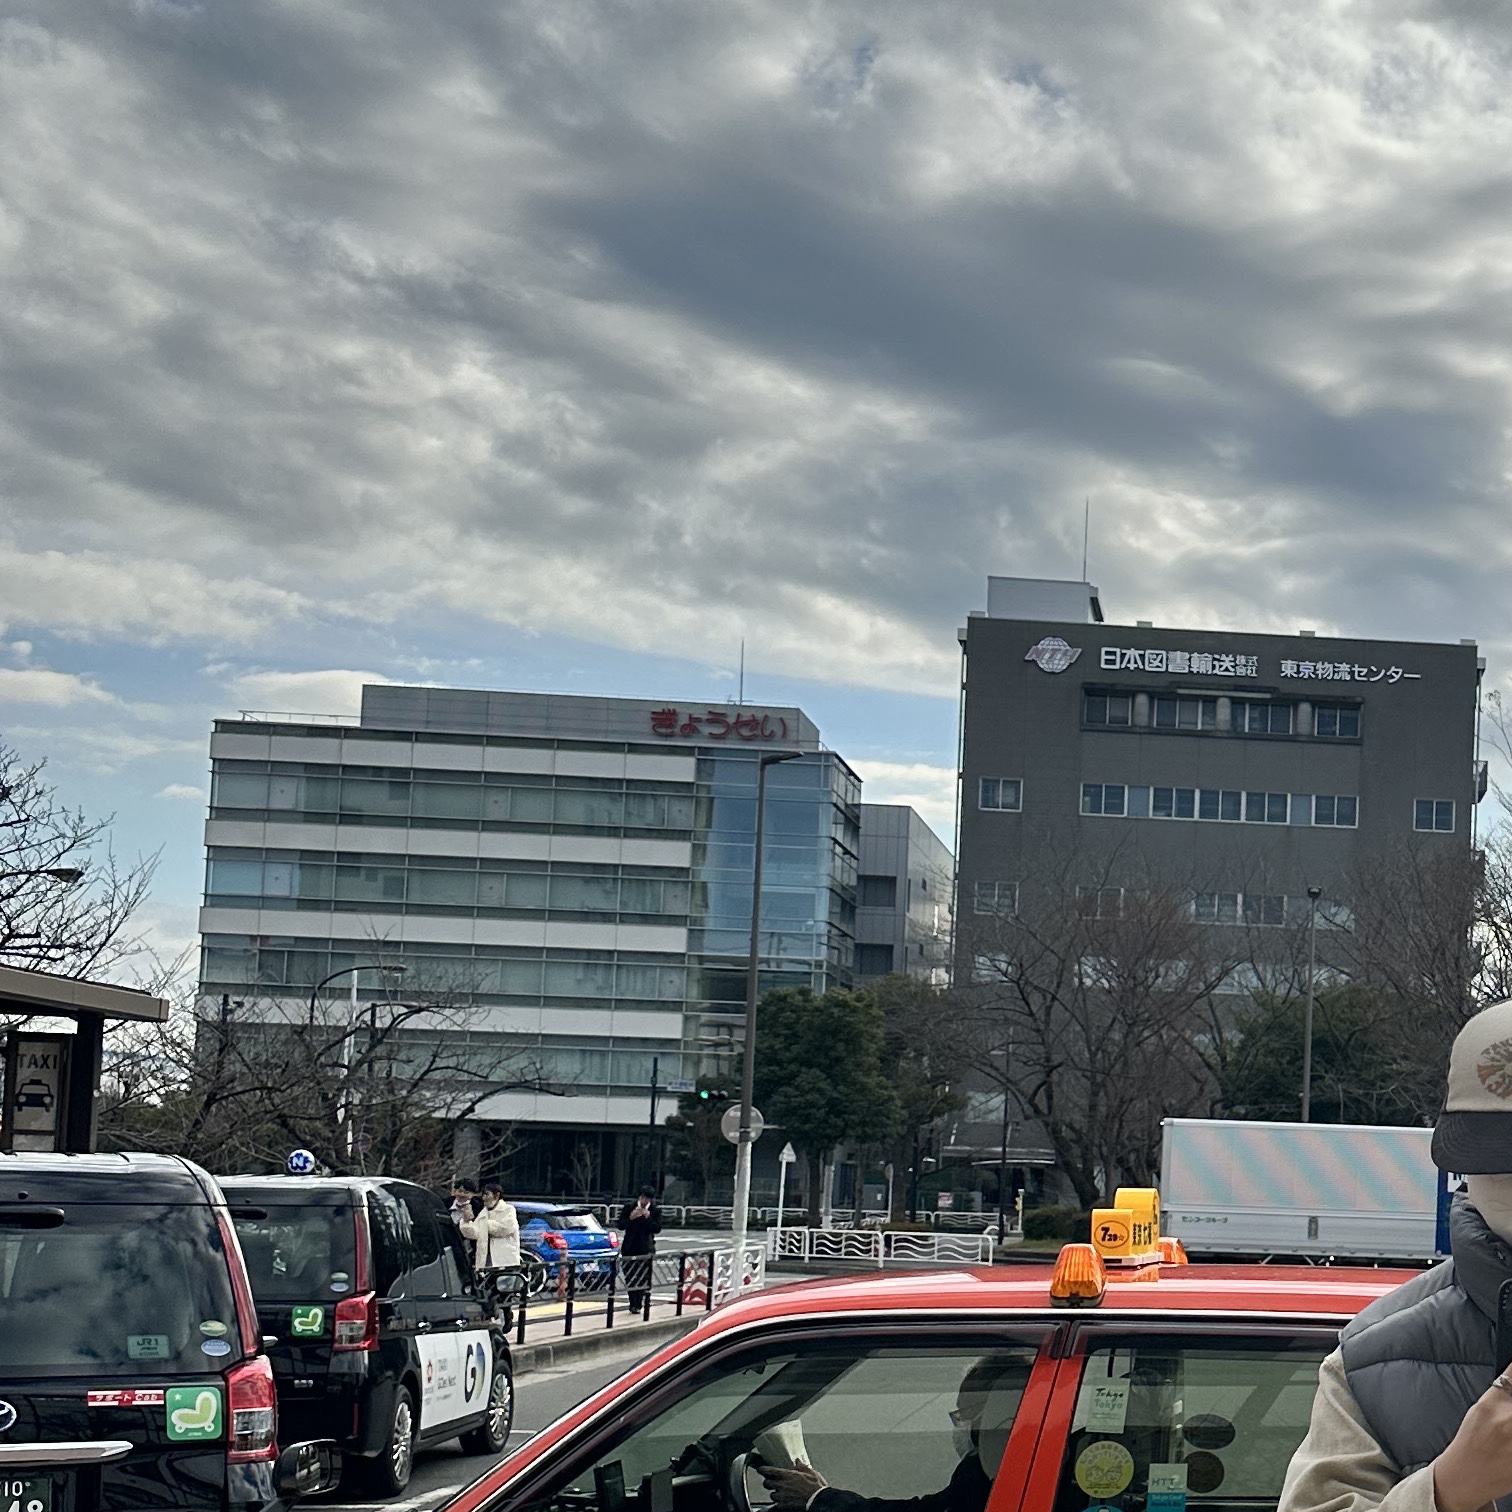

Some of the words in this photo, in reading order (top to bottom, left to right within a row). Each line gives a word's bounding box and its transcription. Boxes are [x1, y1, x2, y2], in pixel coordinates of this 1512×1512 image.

[1280, 659, 1422, 684] 東京物流センター
[650, 707, 787, 741] ぎょうせい
[17, 1053, 58, 1069] TAXI
[134, 1392, 158, 1402] Cab
[1094, 1398, 1123, 1411] Tokyo
